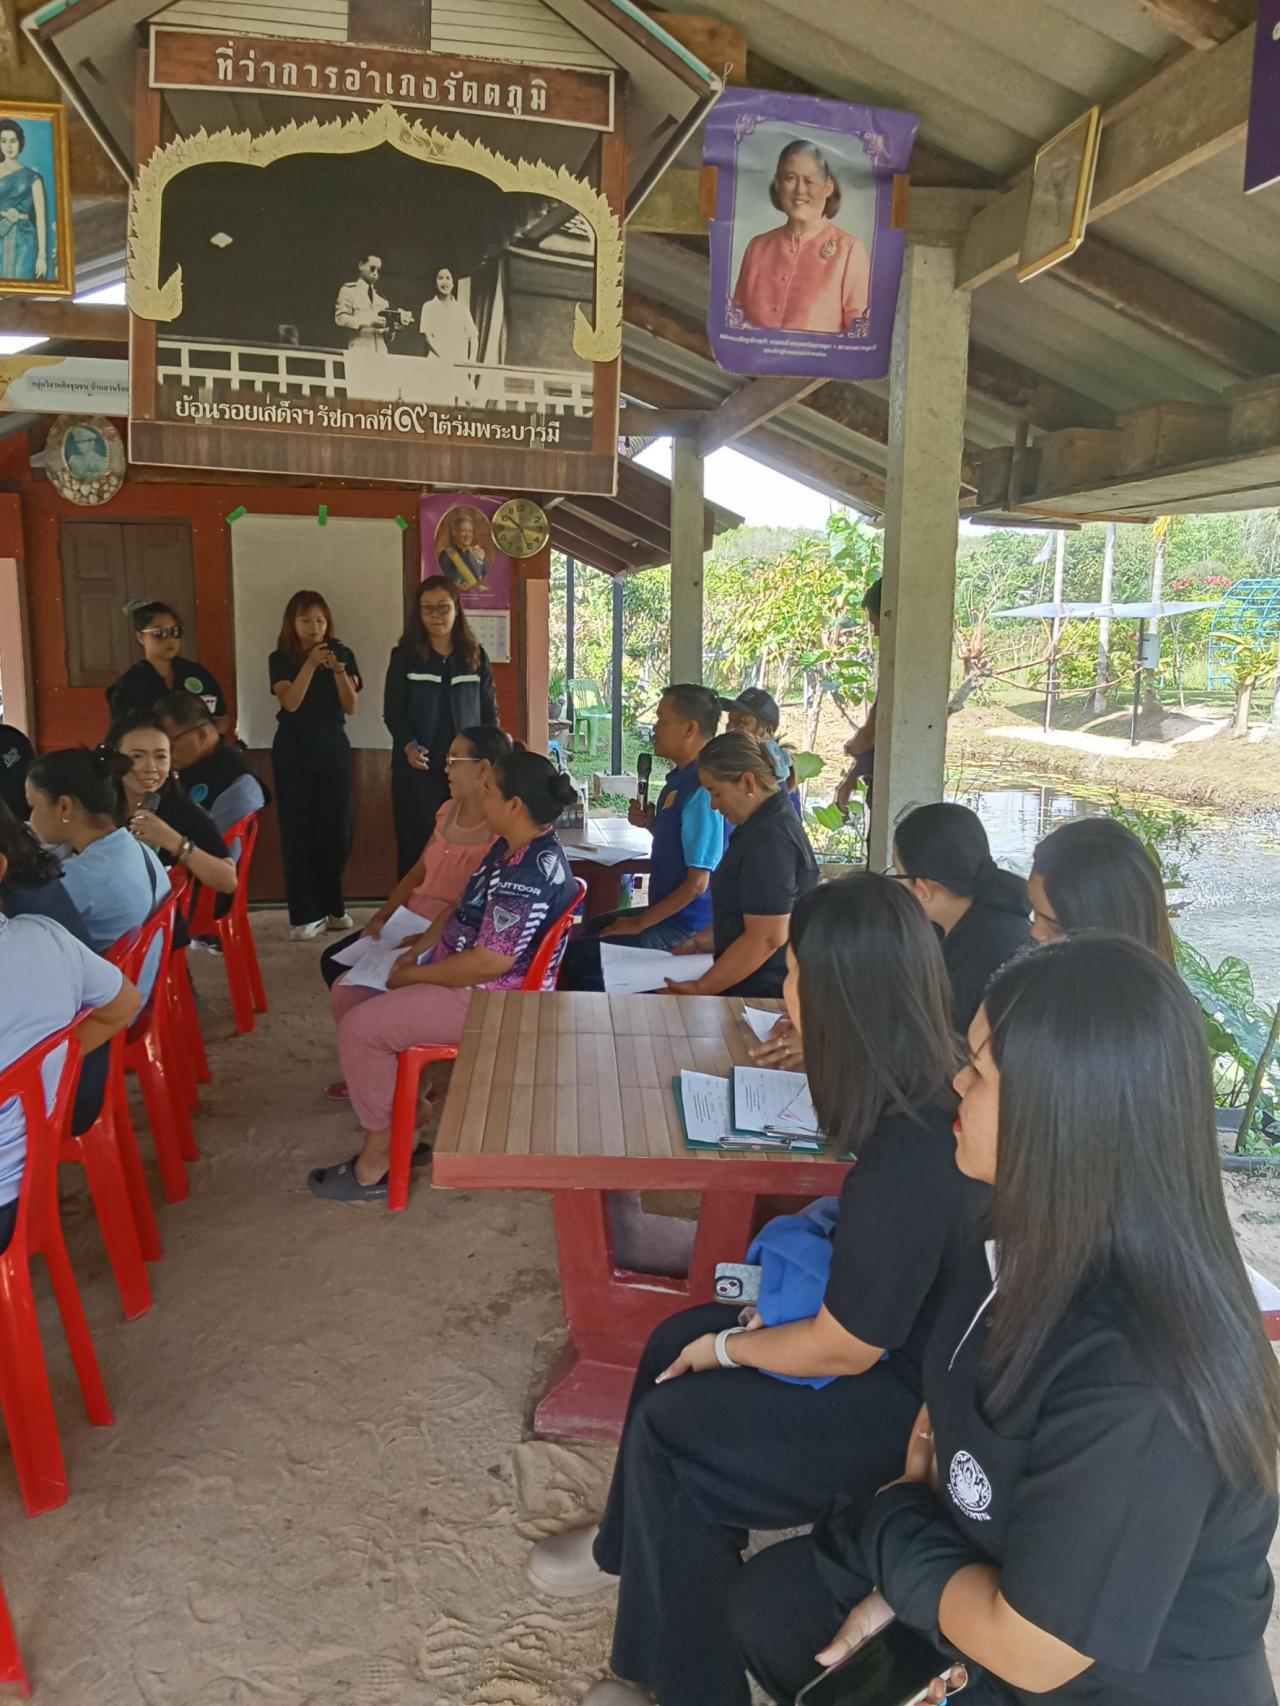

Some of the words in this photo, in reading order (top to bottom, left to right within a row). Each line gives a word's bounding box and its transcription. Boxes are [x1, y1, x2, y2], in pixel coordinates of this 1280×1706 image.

[215, 40, 548, 116] ที่ว่าการอำเภอรัตตภูมิ
[429, 410, 561, 443] ใต้ร่มพระบารมี
